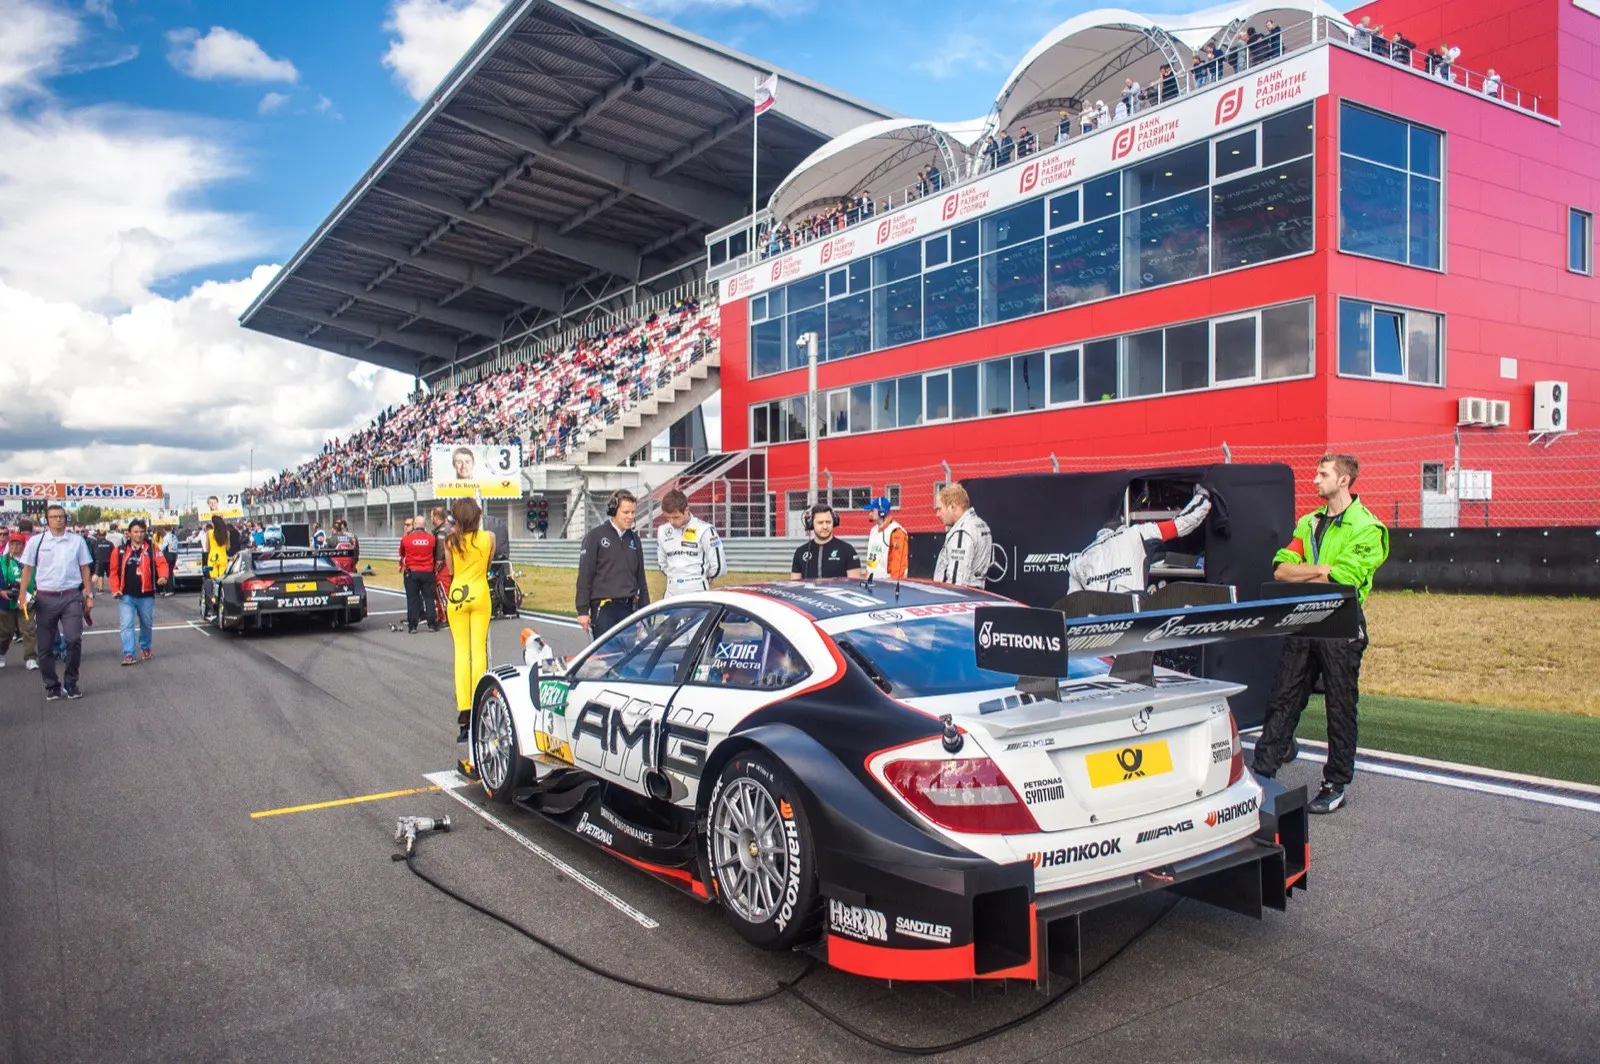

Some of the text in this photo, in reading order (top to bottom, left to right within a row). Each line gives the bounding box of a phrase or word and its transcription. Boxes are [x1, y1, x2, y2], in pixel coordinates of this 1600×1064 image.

[1256, 71, 1307, 98] РАЗВИТИЕ
[1257, 68, 1284, 87] БАНК
[1255, 86, 1301, 109] СТОЛИЦА
[1138, 119, 1179, 141] РАЗВИТИЕ
[1139, 116, 1160, 131] БАНК
[1137, 132, 1175, 152] СТОЛИЦА
[1041, 157, 1076, 176] РАЗВИТИЕ
[1042, 153, 1060, 166] БАНК
[1040, 169, 1072, 187] СТОЛИЦА
[499, 449, 511, 470] 3
[66, 484, 159, 498] kfzteile24
[227, 494, 239, 504] 27
[276, 550, 311, 558] Audi
[1023, 564, 1046, 572] DTM
[277, 596, 329, 608] PLAYBOY
[1067, 620, 1133, 635] PETRONAS
[1169, 616, 1264, 637] PETRONAS
[730, 644, 759, 660] DIR
[729, 660, 761, 669] Реста
[547, 711, 554, 735] 3
[572, 700, 710, 780] AMG
[1024, 777, 1062, 789] PETRONAS
[1025, 785, 1064, 805] SYNTIUM
[1217, 796, 1258, 825] Hankook
[583, 821, 613, 846] PETRONAS
[614, 819, 653, 843] PERFORMANCE
[1042, 837, 1121, 868] Hankook
[775, 820, 801, 934] Hankook
[896, 916, 952, 938] SANDTLER
